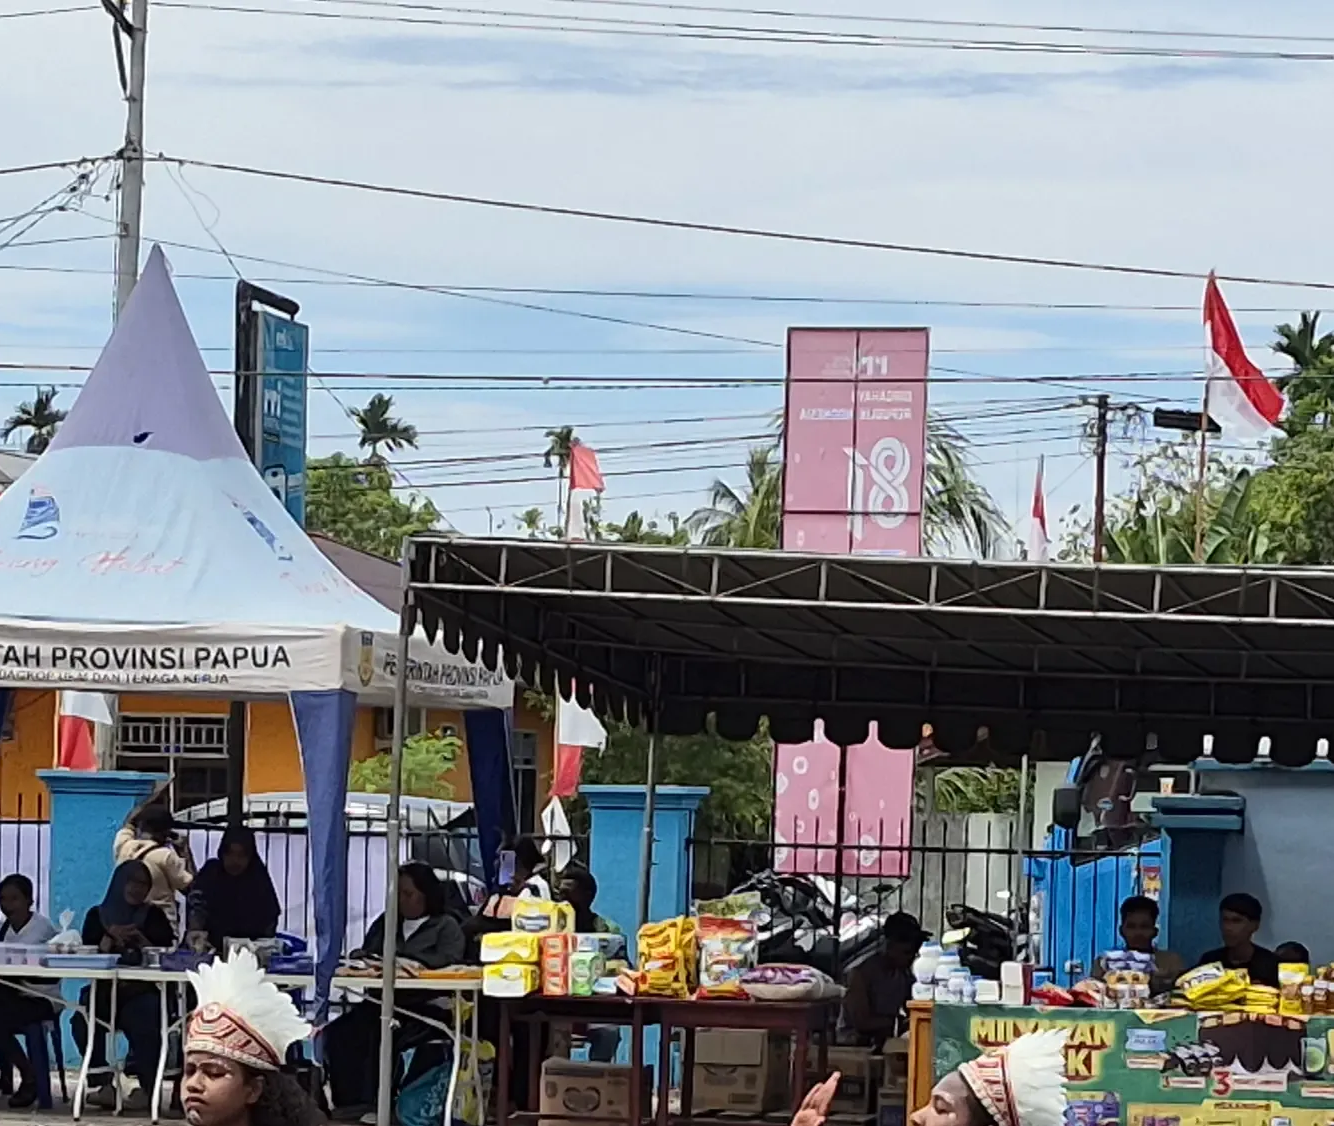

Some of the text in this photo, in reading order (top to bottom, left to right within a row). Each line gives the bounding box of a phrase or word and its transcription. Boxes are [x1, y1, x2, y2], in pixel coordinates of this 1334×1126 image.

[51, 645, 186, 670] PROVINSI
[194, 644, 291, 670] PAPUA
[92, 671, 122, 684] DAN
[1213, 1070, 1231, 1096] 3
